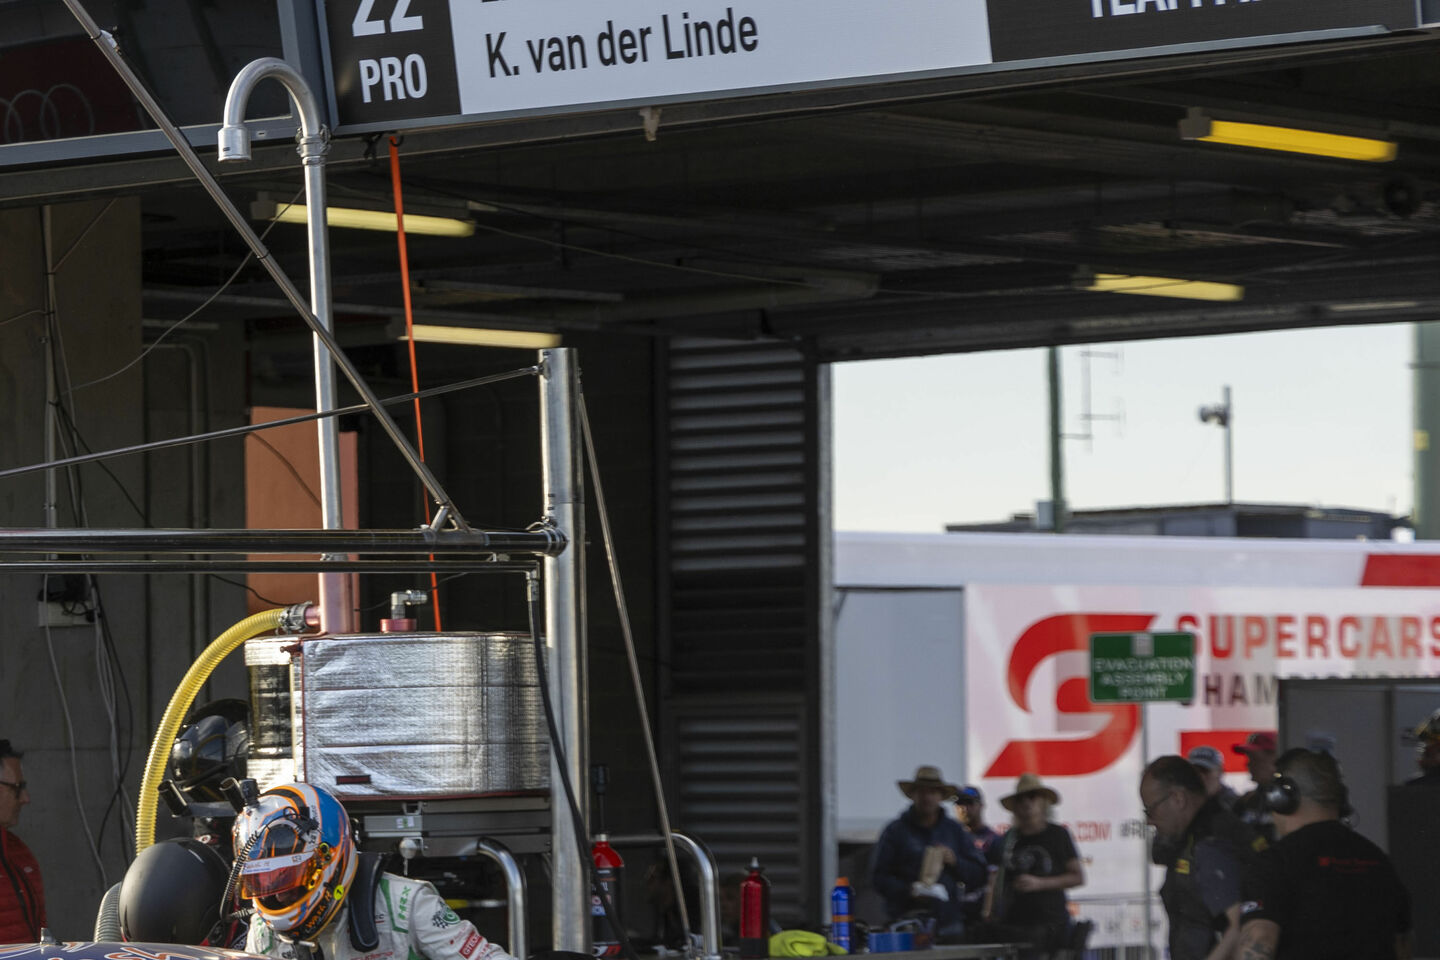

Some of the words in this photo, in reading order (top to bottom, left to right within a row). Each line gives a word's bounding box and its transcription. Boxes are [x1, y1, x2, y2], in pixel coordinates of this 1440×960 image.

[486, 31, 520, 78] K.
[526, 33, 588, 73] van
[597, 20, 652, 67] der
[661, 7, 759, 60] Linde
[360, 53, 428, 103] PRO
